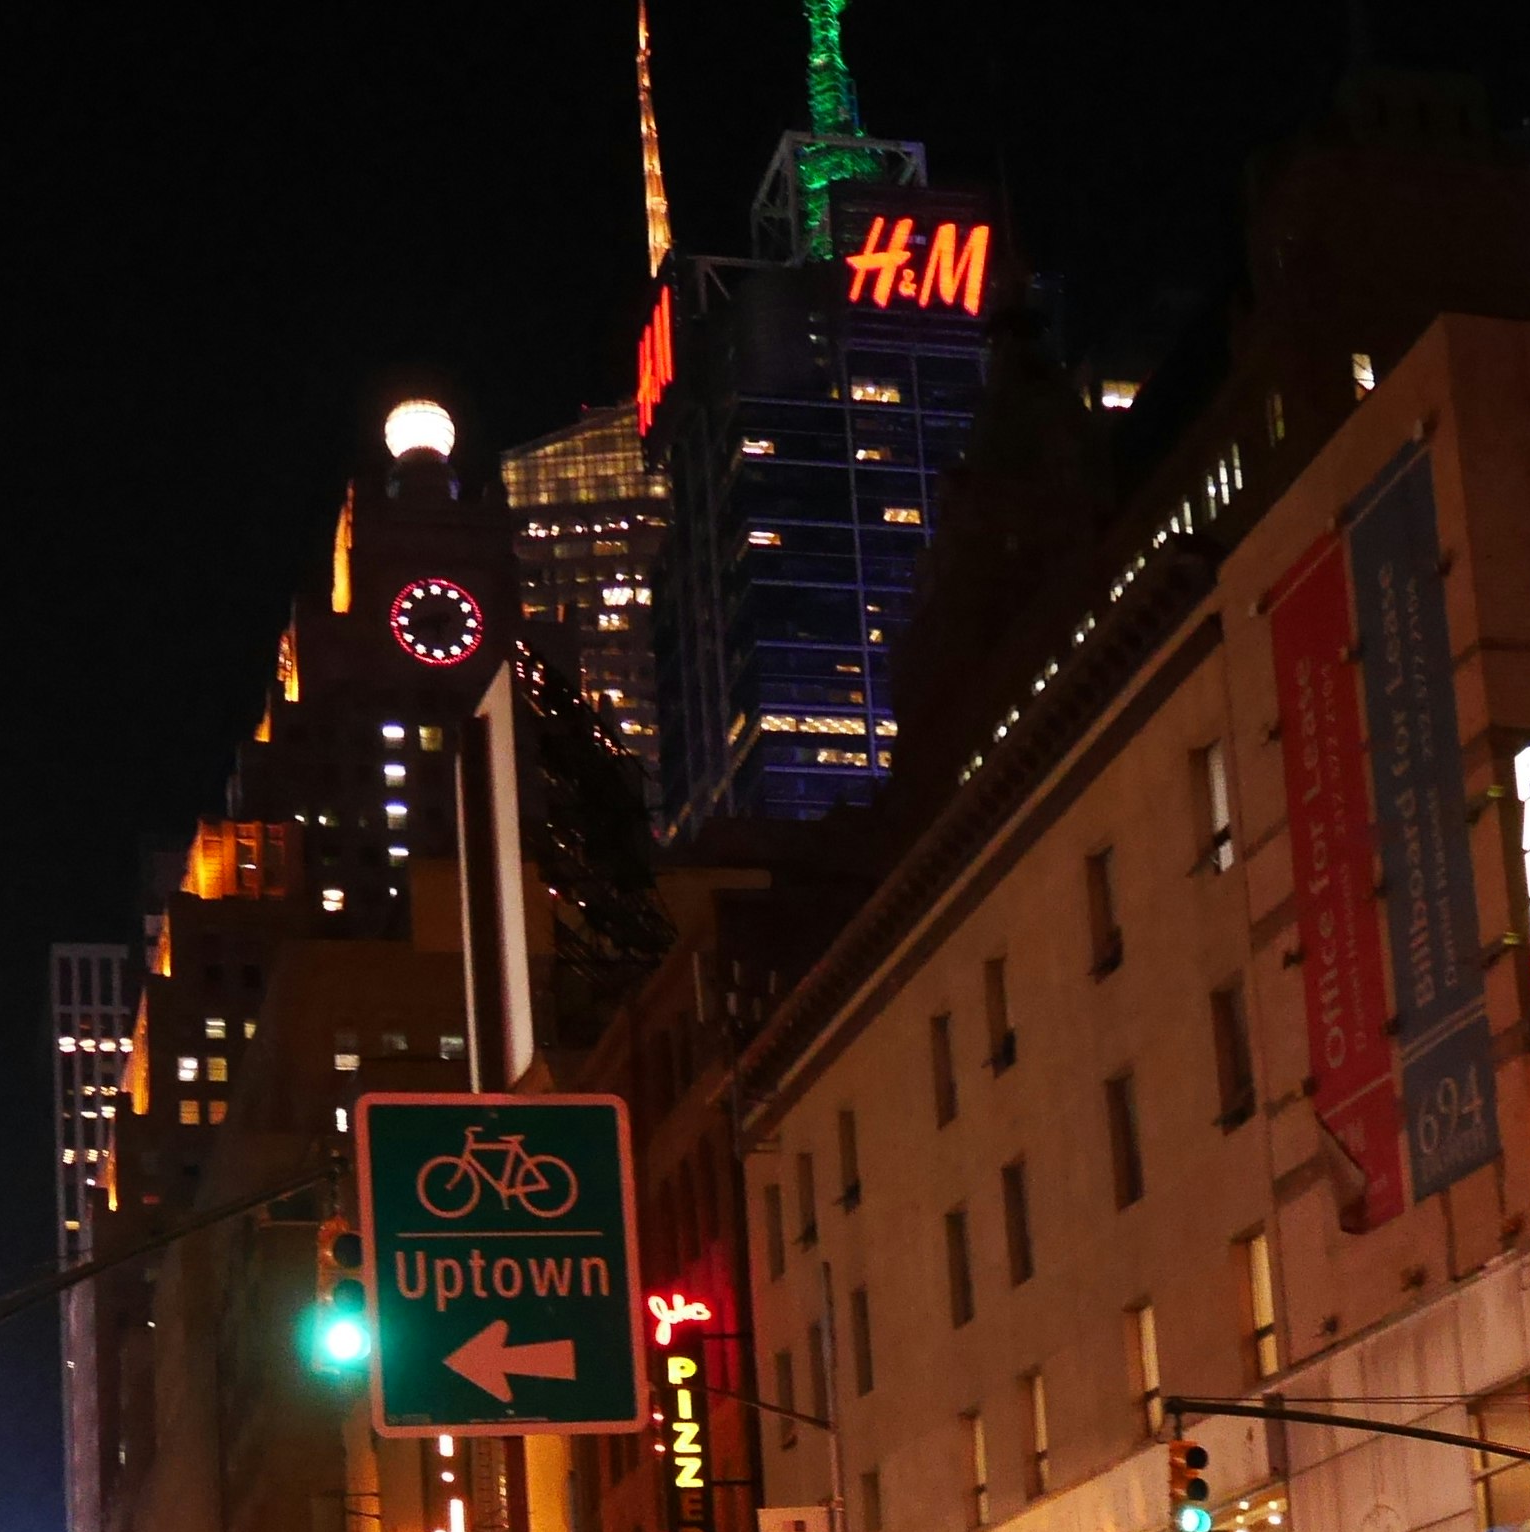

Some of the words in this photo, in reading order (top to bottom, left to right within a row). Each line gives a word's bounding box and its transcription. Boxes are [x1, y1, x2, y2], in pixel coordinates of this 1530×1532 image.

[845, 216, 990, 317] H&M
[1385, 704, 1413, 778] for
[1304, 820, 1331, 896] for
[1395, 787, 1437, 1009] Billboard
[1314, 908, 1349, 1070] Office
[394, 1250, 611, 1313] Uptown
